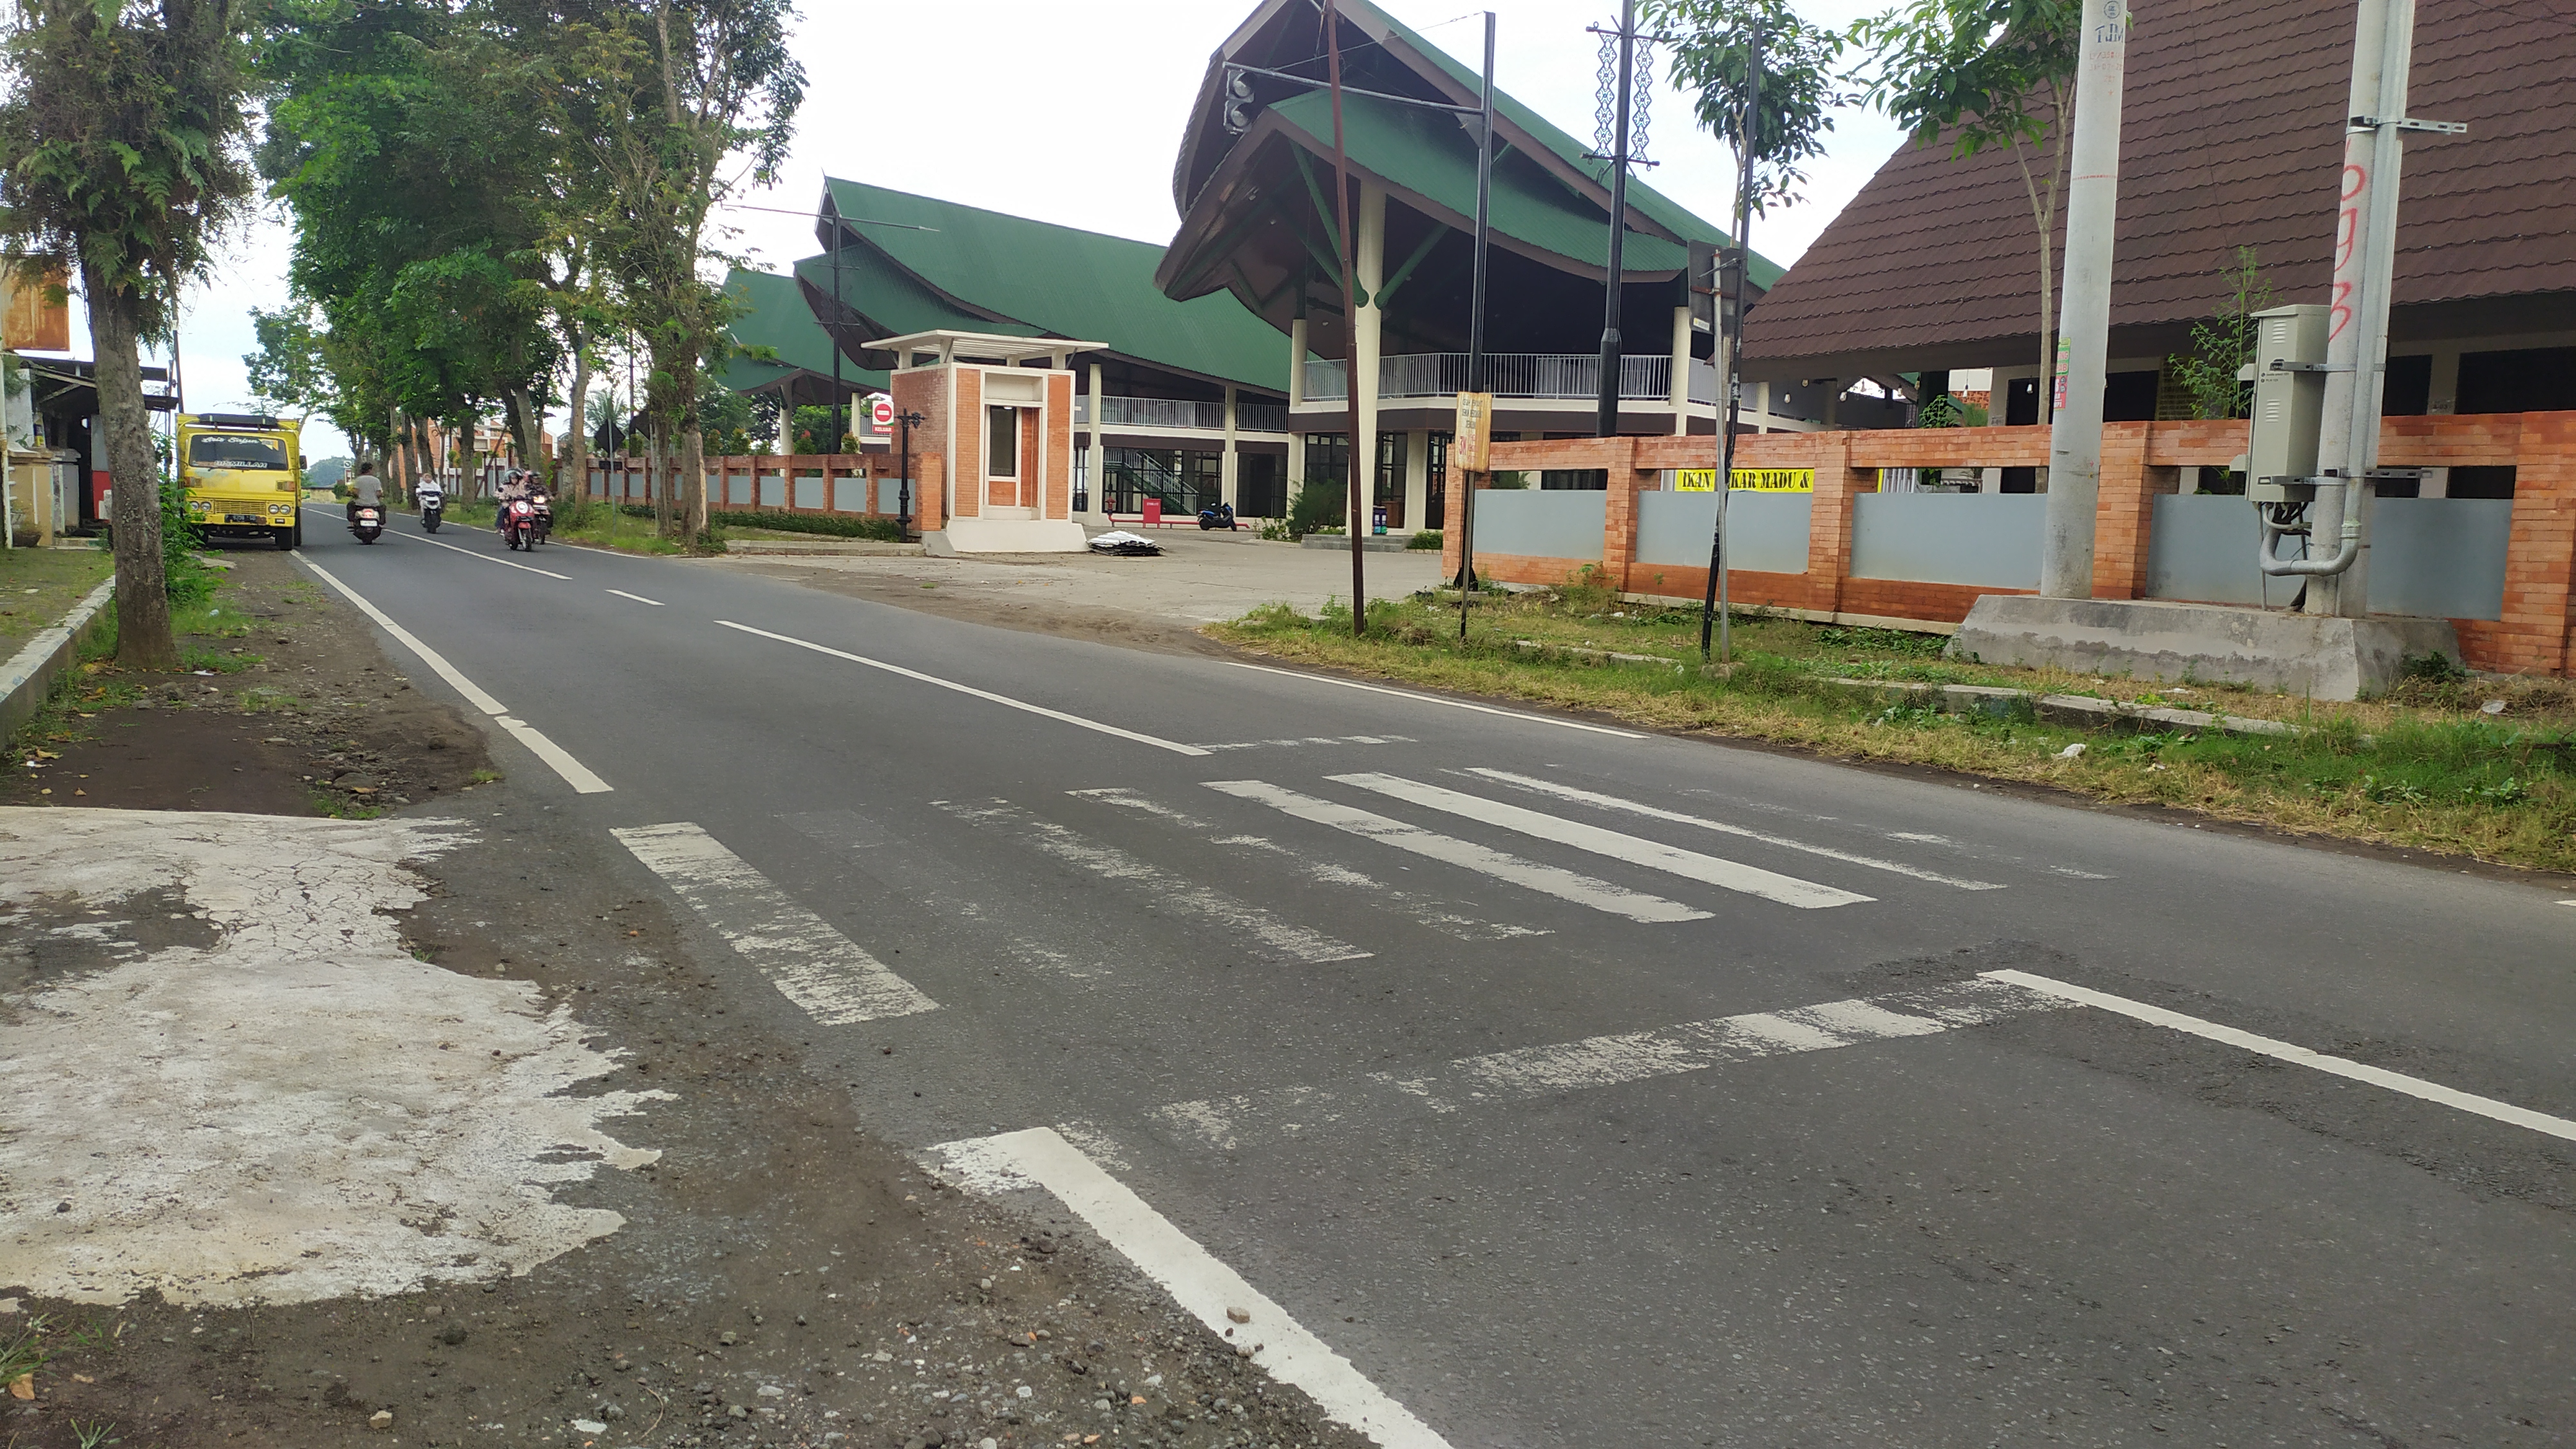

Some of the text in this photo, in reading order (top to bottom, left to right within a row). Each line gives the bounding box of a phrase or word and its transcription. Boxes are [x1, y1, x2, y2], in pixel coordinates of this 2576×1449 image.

[1459, 435, 1467, 455] 3M
[1682, 471, 1712, 488] IKAN
[1761, 471, 1796, 489] MADU
[1799, 471, 1810, 489] &
